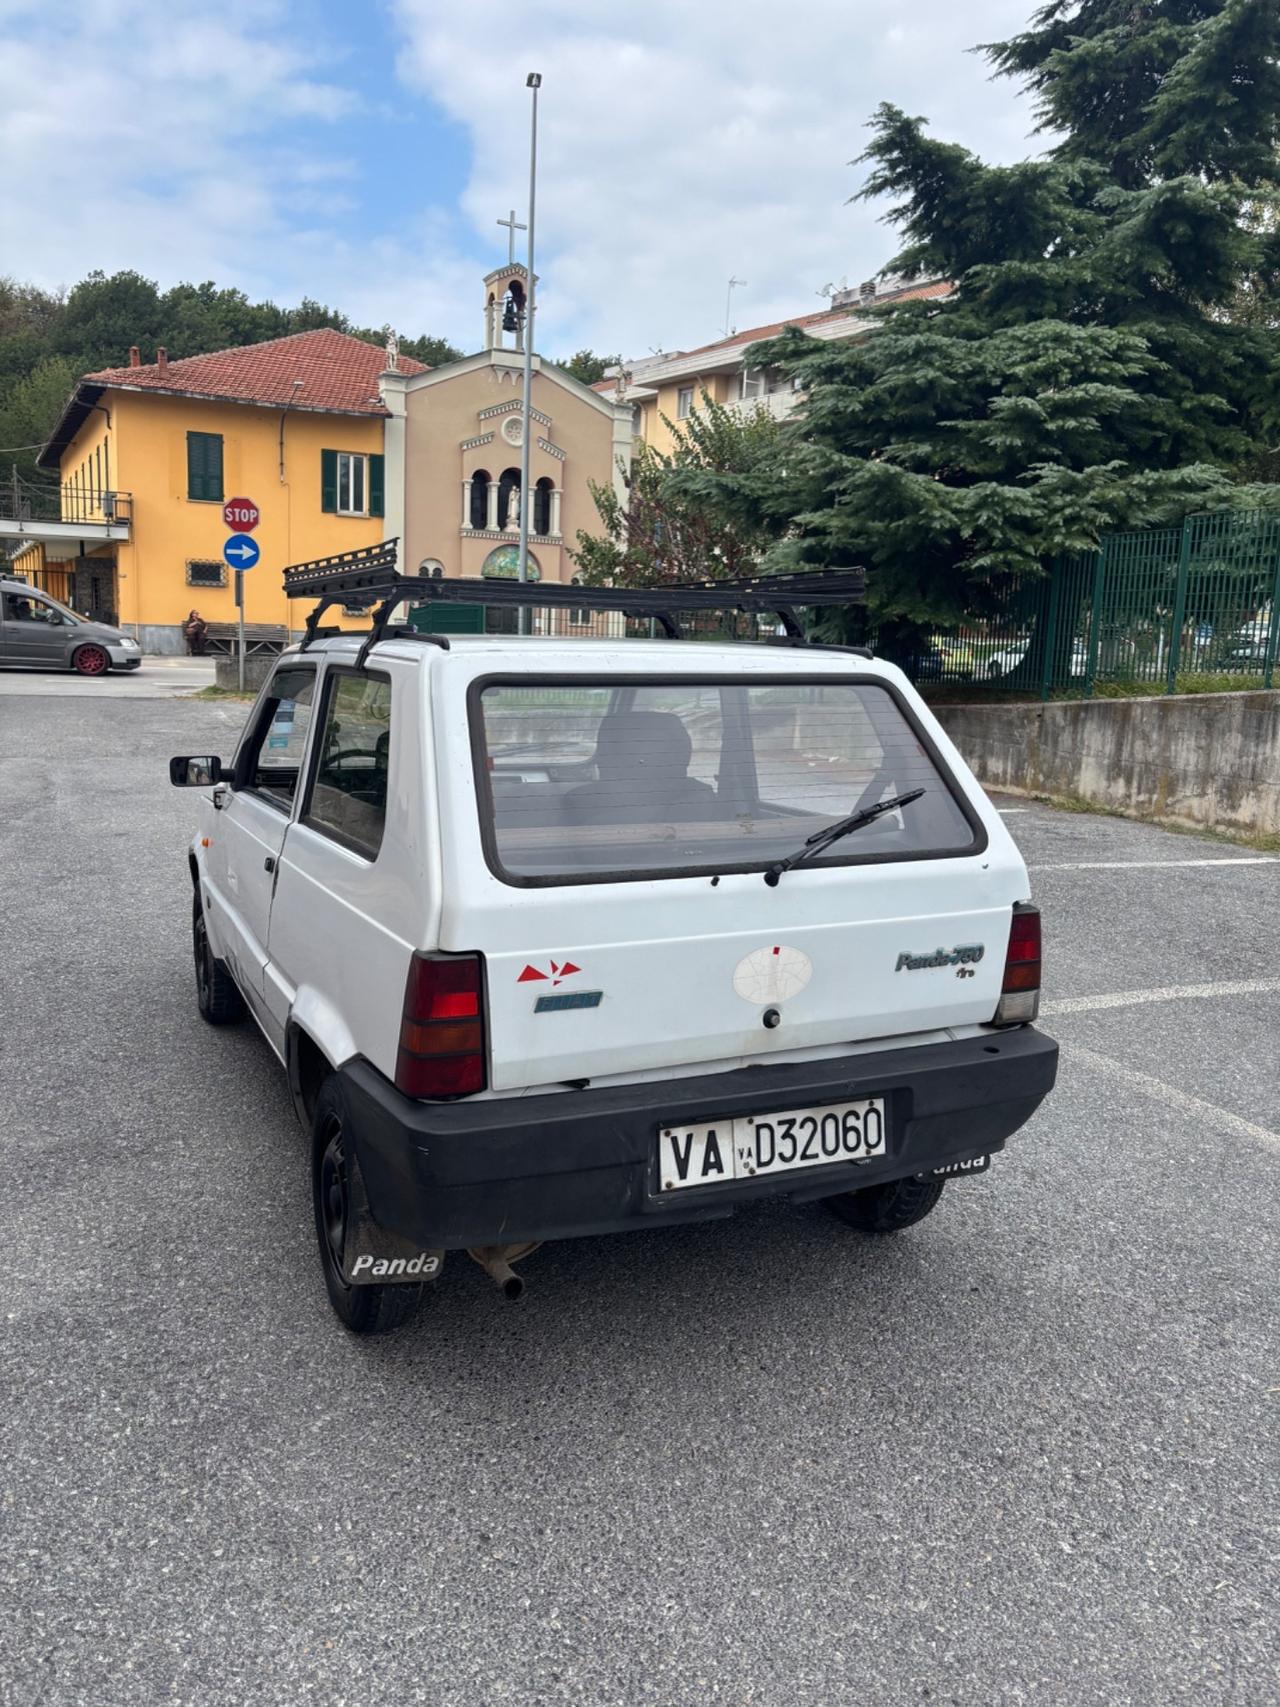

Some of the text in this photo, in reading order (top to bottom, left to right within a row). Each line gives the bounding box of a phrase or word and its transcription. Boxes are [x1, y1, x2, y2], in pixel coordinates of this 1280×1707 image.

[225, 508, 257, 522] STOP
[670, 1107, 882, 1180] VA D32060
[738, 1147, 753, 1160] VA
[351, 1252, 439, 1276] Panda
